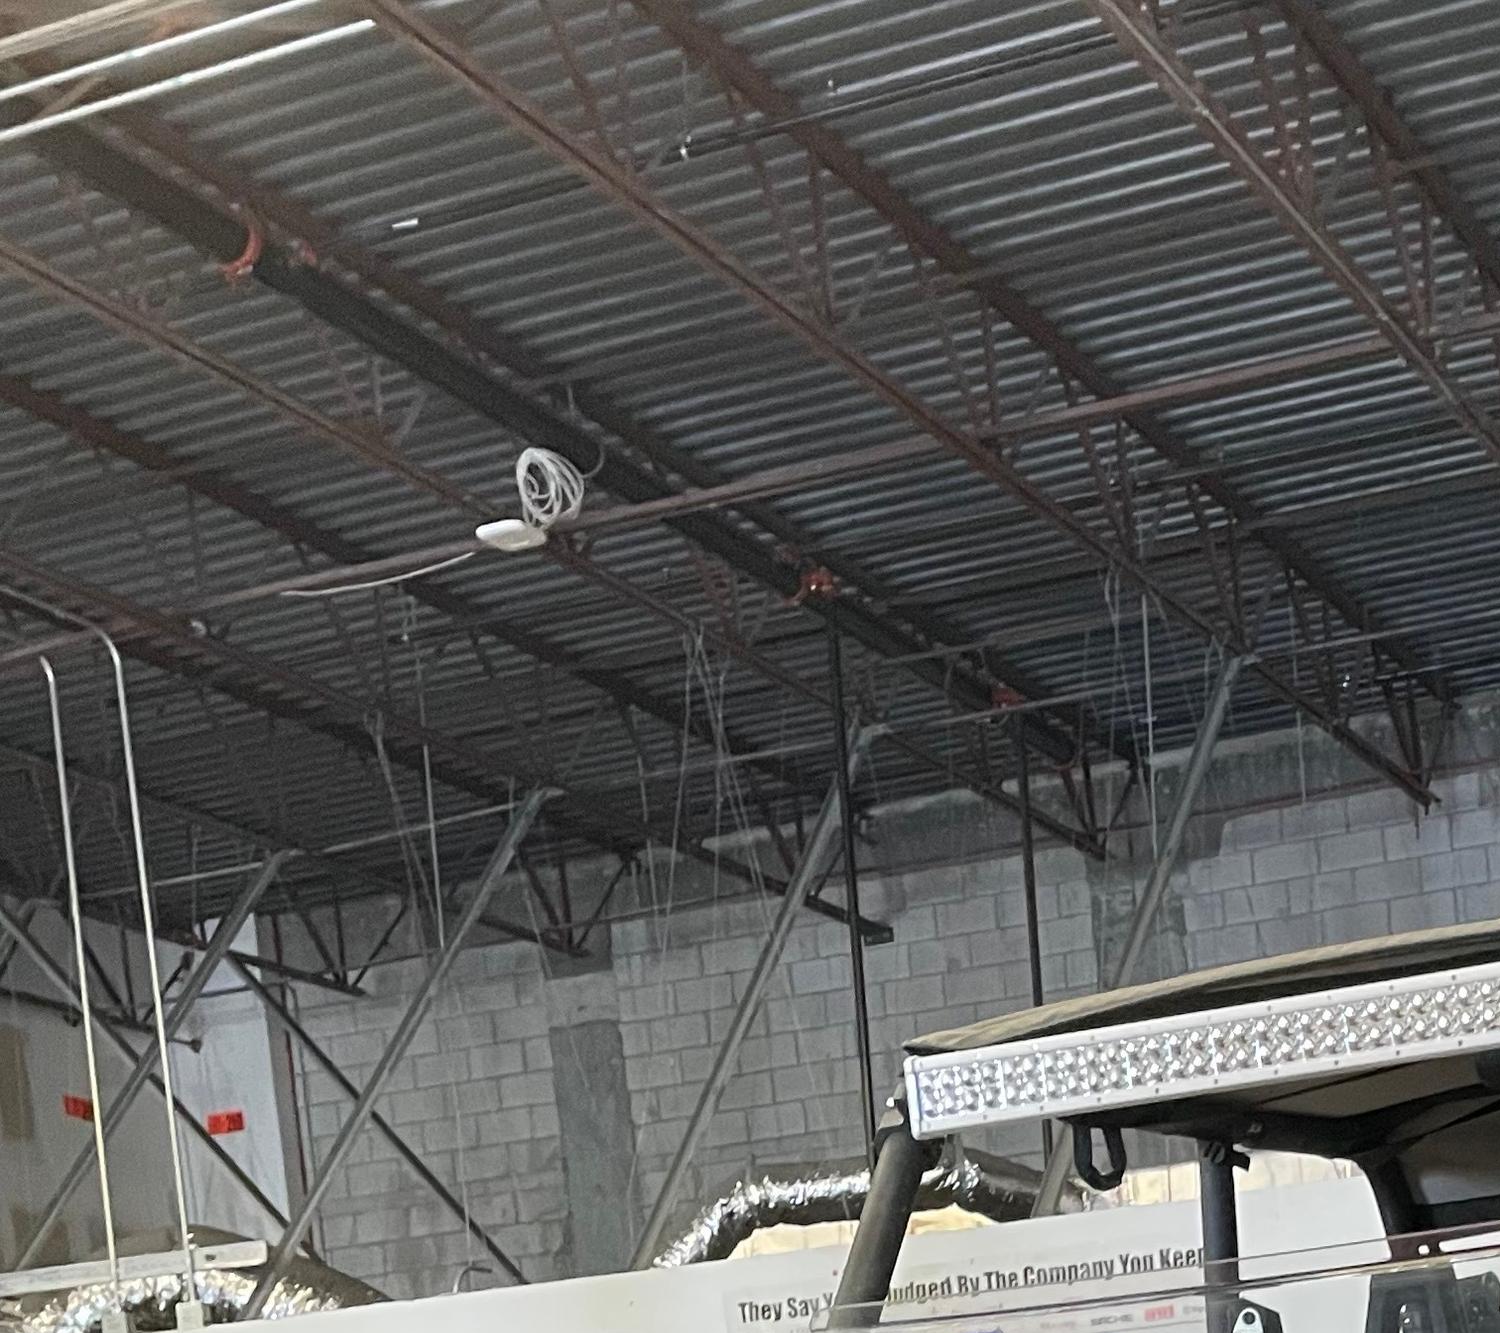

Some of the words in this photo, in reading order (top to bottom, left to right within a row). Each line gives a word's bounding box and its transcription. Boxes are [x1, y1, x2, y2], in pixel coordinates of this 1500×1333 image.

[983, 1270, 1019, 1289] The
[1023, 1256, 1115, 1286] Company
[738, 1300, 783, 1323] They
[786, 1296, 819, 1318] Say
